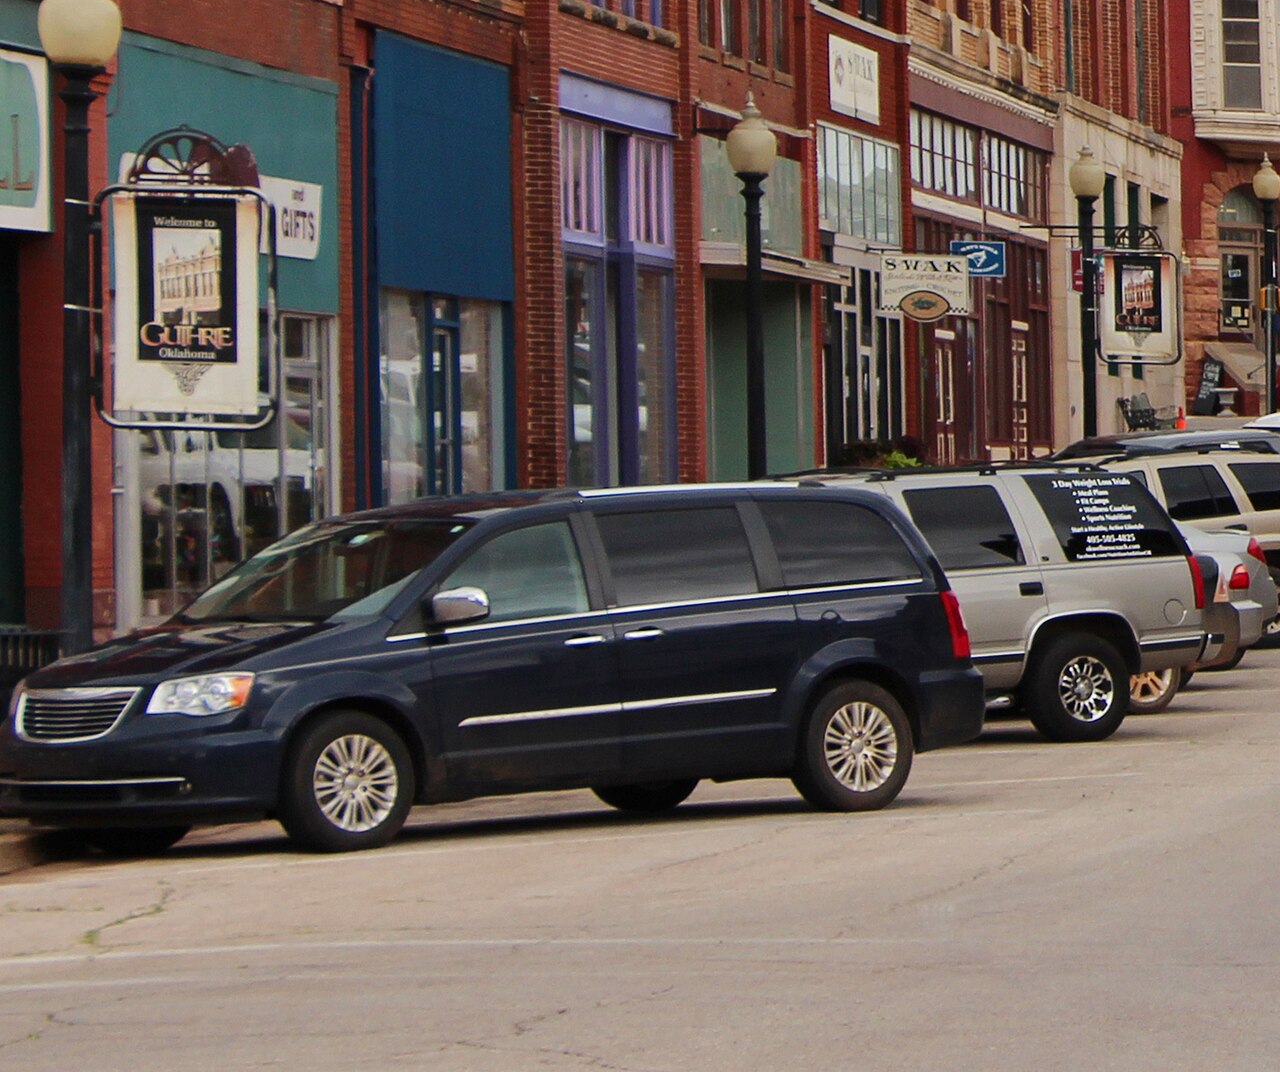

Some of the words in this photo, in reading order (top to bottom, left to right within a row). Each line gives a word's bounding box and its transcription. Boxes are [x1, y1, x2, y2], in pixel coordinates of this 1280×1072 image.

[153, 215, 202, 227] Welcome
[203, 217, 217, 227] to
[281, 207, 315, 242] GIFTS
[158, 348, 216, 360] Oklahoma
[1059, 480, 1072, 489] Day
[1072, 478, 1098, 488] Weight
[1097, 478, 1113, 486] Loss
[1112, 477, 1131, 485] Trials
[1109, 504, 1137, 513] Coaching
[1105, 513, 1132, 521] Nutrition
